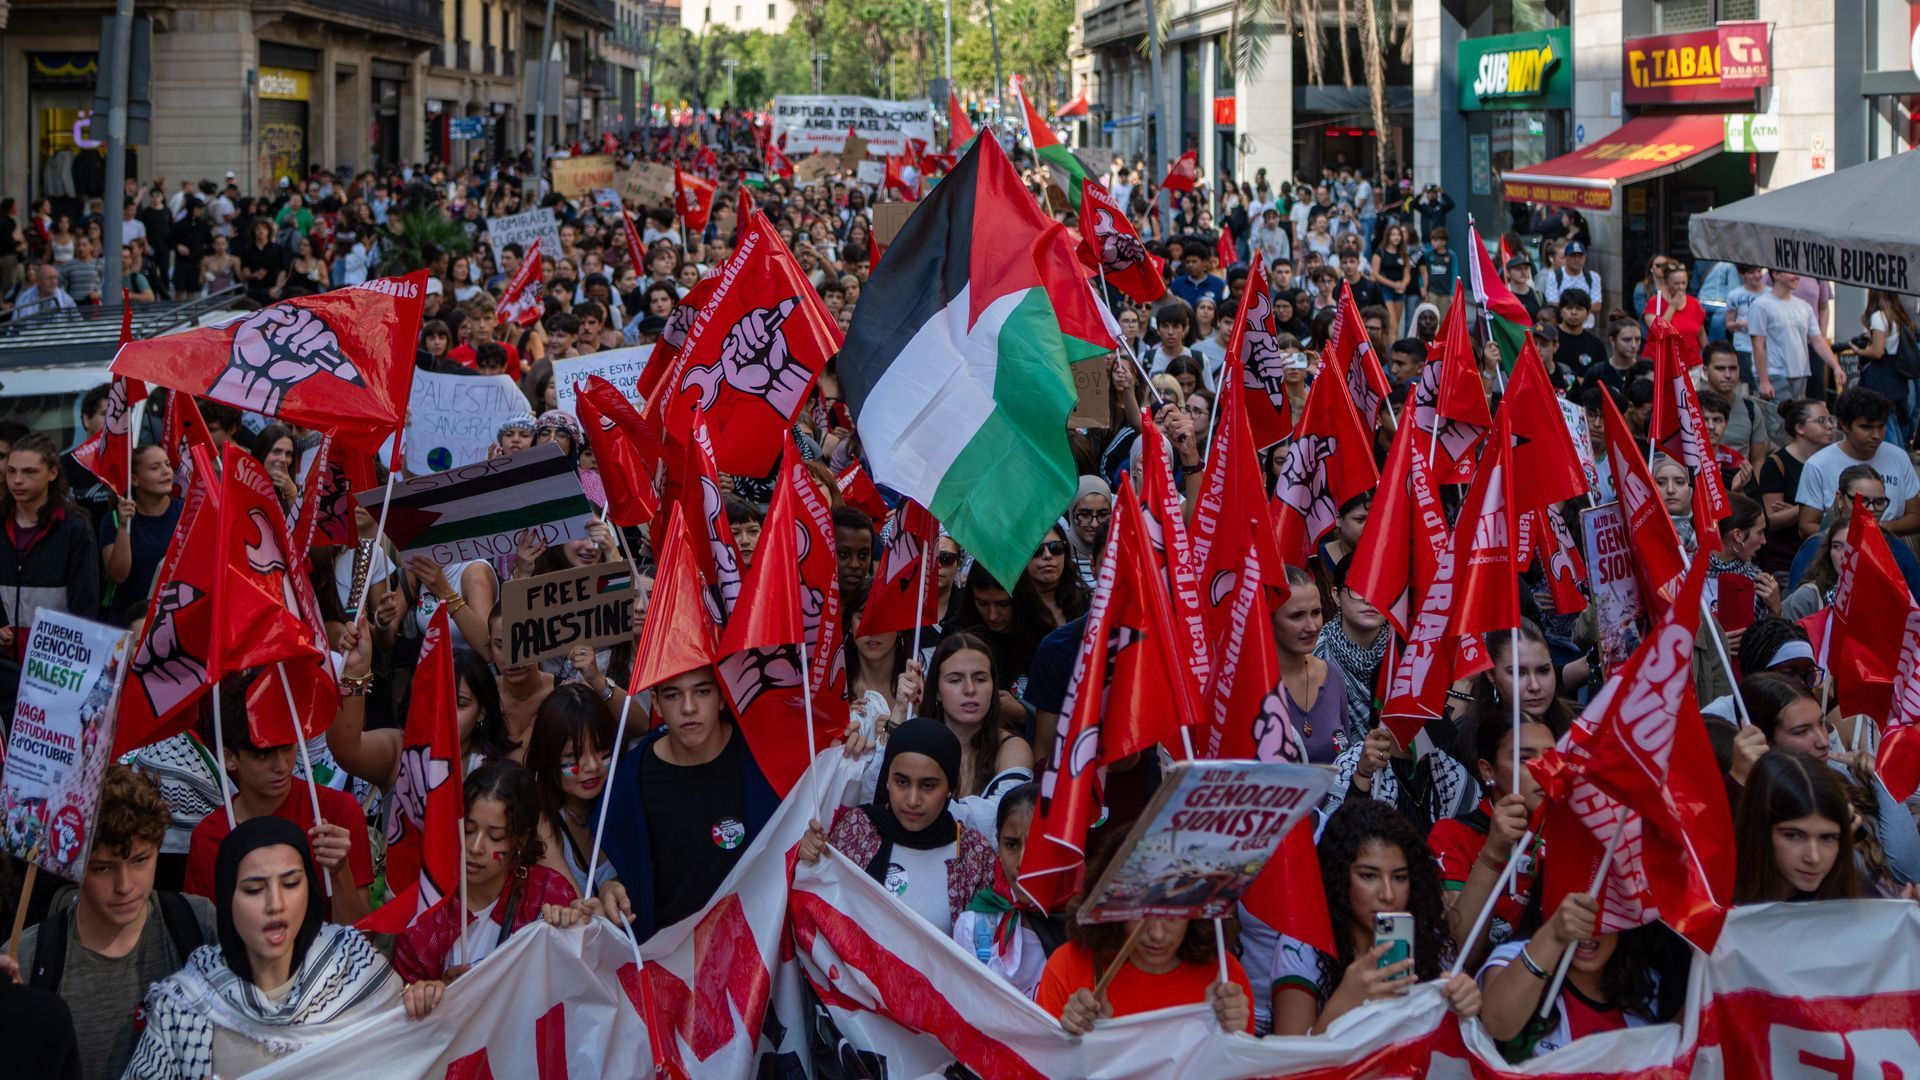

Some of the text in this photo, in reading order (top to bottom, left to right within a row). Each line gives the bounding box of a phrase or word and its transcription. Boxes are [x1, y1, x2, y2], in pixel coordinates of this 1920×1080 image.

[1473, 43, 1554, 97] SUBWAY
[1723, 65, 1767, 76] TABACS
[837, 119, 881, 132] ISRAEL
[1753, 126, 1778, 136] ATM
[1774, 237, 1909, 290] NEW YORK BURGER
[691, 230, 761, 339] d'Estudiants
[609, 359, 634, 375] ESTÁ
[413, 374, 529, 414] PALESTINA
[423, 413, 493, 441] SANGRA
[406, 458, 513, 491] STOP
[1593, 513, 1619, 530] ALTO AL
[527, 577, 591, 611] FREE
[36, 620, 84, 645] ATUREM EL
[511, 599, 634, 665] PALESTINE
[30, 649, 51, 662] CONTRA
[33, 633, 92, 665] GENOCIDI
[27, 656, 88, 693] PALESTÍ
[18, 700, 46, 726] VAGA
[14, 718, 76, 751] ESTUDIANTIL
[11, 733, 74, 766] 2 d'OCTUBRE
[1200, 770, 1249, 783] ALTO AL
[1184, 783, 1310, 811] GENOCIDI
[1162, 809, 1290, 838] SIONISTA
[1228, 840, 1240, 852] A
